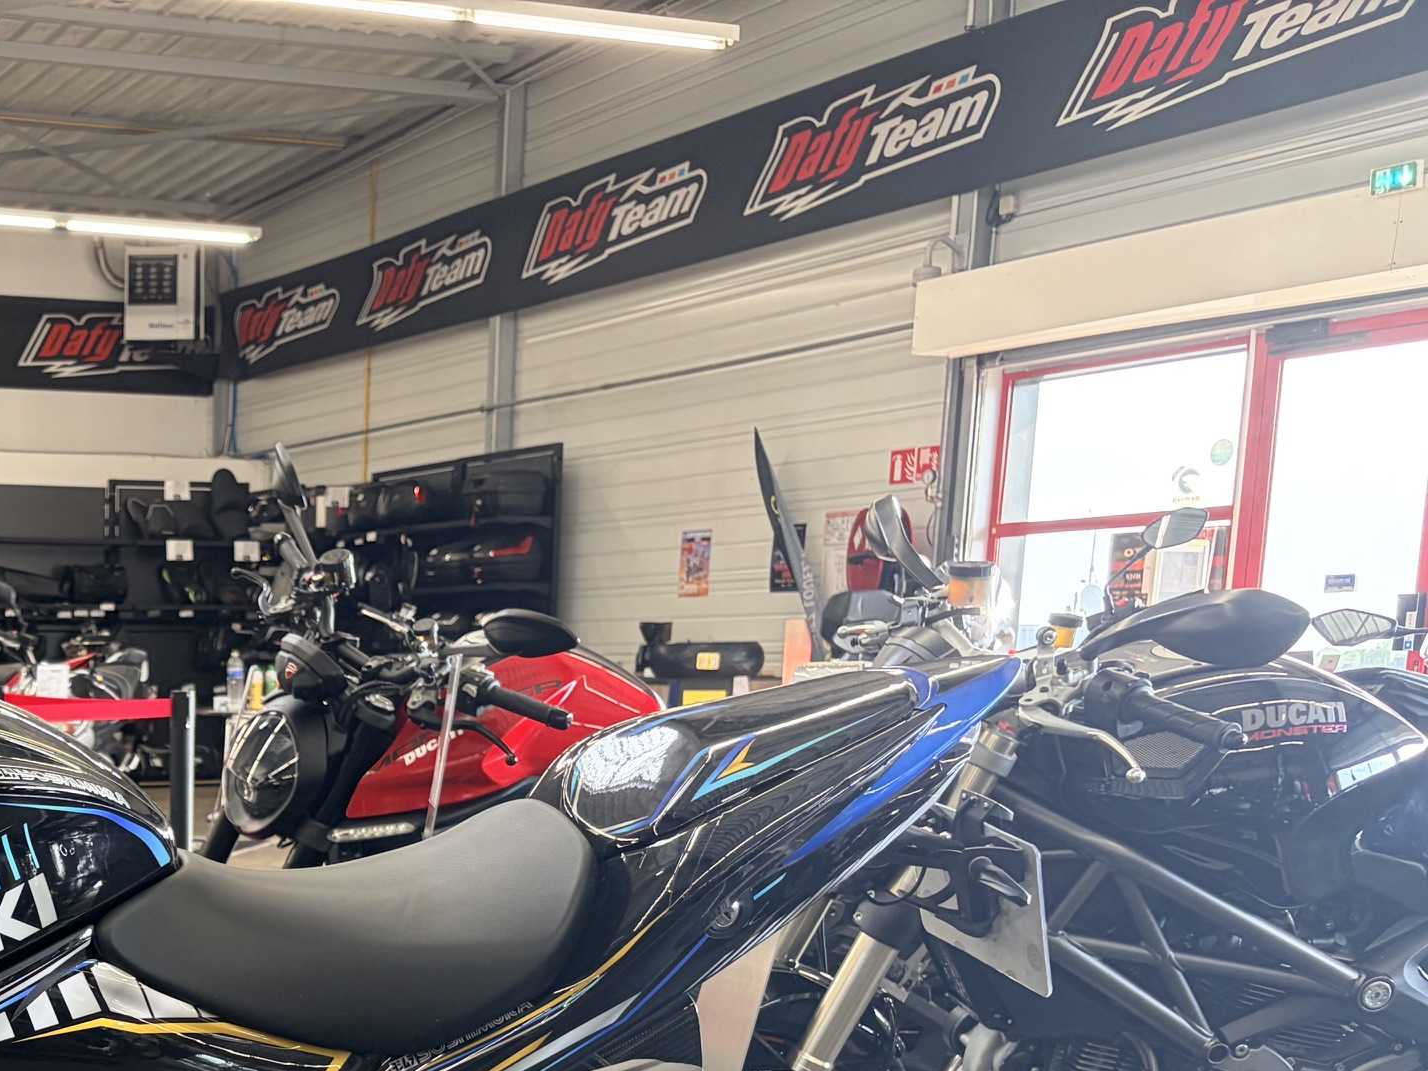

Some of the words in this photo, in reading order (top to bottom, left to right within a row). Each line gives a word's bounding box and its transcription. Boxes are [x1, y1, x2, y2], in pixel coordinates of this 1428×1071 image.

[768, 106, 880, 194] Dafy
[864, 89, 989, 166] Team
[538, 191, 619, 262] Dafy
[607, 182, 699, 241] Team
[422, 248, 485, 296] Team
[275, 299, 333, 337] Team
[39, 322, 121, 362] Dafy
[1242, 701, 1347, 732] DUCATI
